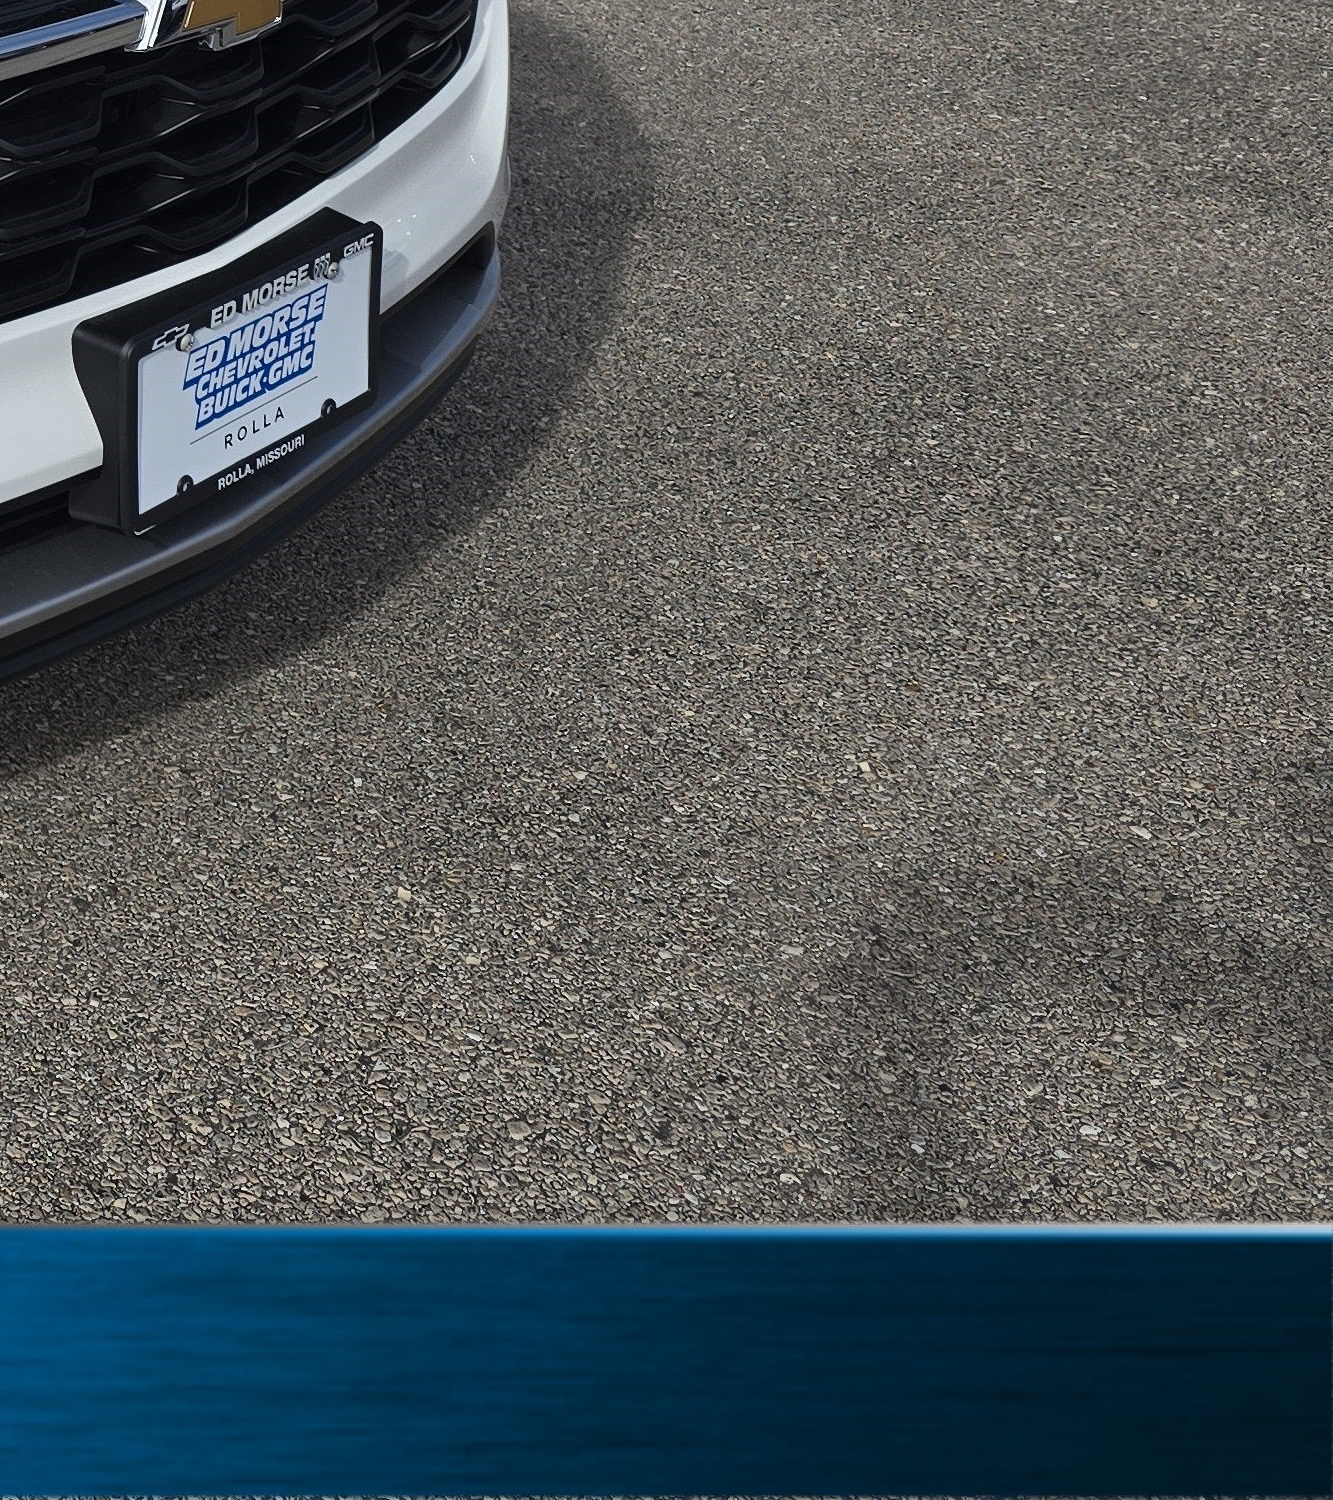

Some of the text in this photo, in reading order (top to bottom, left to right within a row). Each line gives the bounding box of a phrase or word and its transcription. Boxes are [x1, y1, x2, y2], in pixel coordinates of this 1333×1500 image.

[343, 232, 375, 258] GMC
[210, 263, 310, 329] ED MORSE
[185, 286, 327, 383] ED MORSE
[224, 406, 285, 450] ROLLA
[217, 433, 305, 491] ROLLA, MISSOURI
